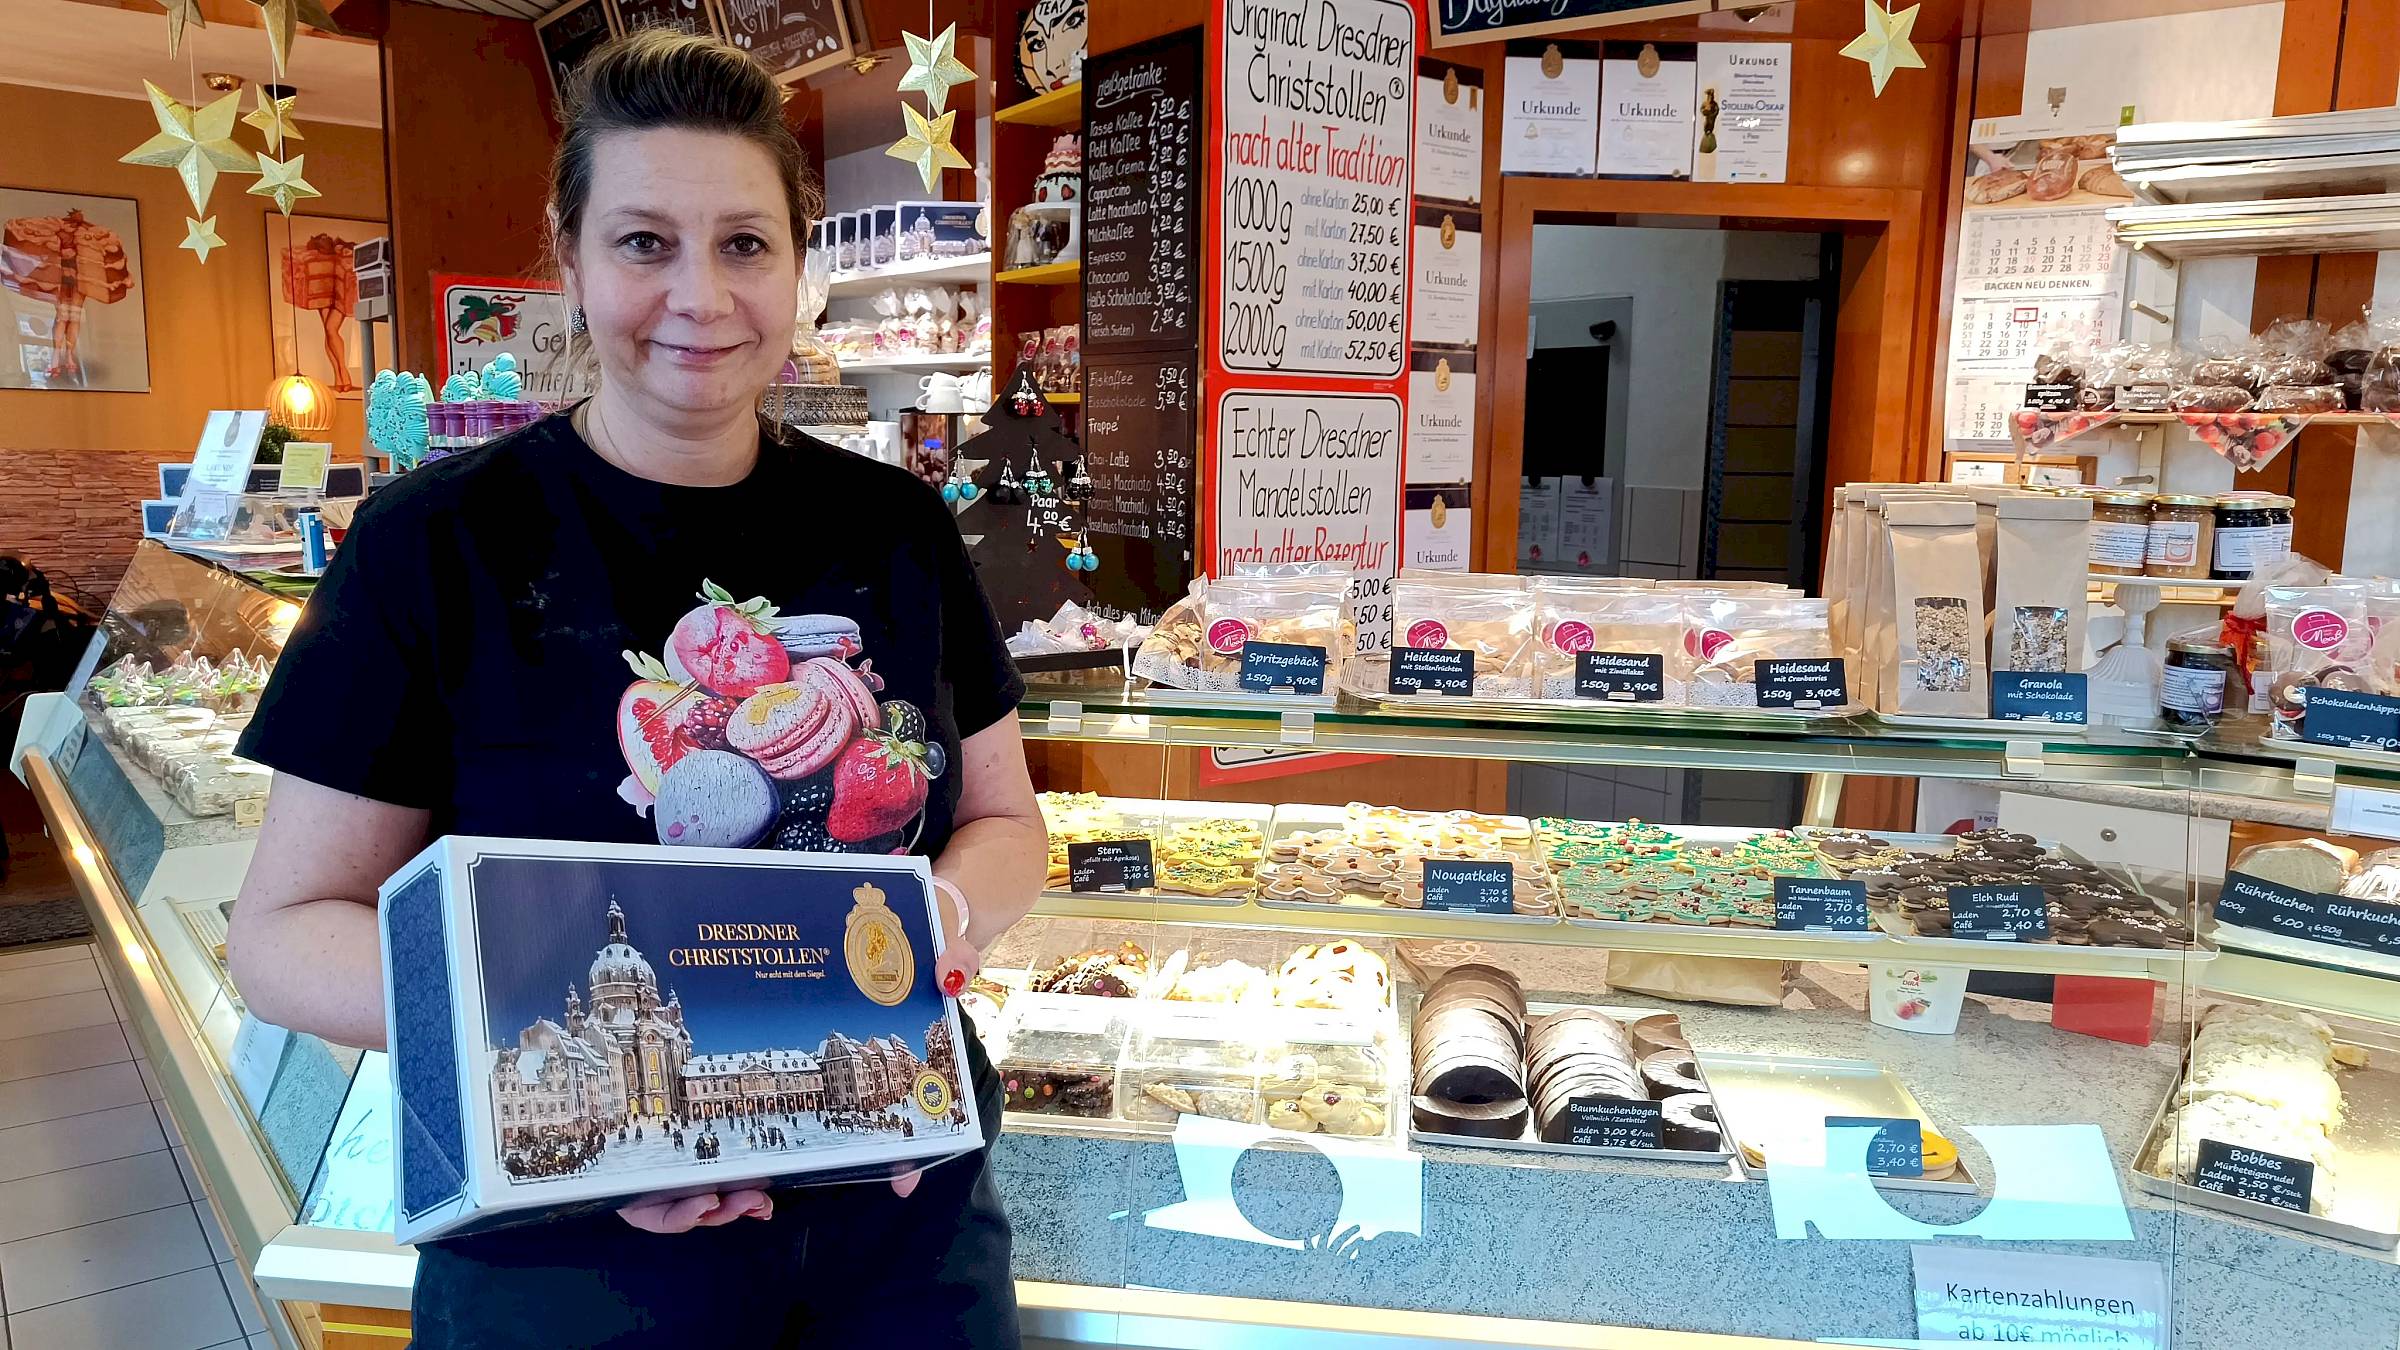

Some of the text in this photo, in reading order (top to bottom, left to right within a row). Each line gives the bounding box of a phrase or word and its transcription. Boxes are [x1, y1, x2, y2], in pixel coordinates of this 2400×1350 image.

[1230, 0, 1308, 52] Original
[1318, 1, 1410, 68] Dresdner
[1148, 97, 1175, 128] 2,50
[1522, 100, 1581, 116] Urkunde
[1619, 102, 1678, 118] Urkunde
[1089, 122, 1174, 159] Pott Kaffee 4,00
[1429, 123, 1471, 143] Urkunde
[1230, 115, 1405, 188] nach alter Tradition
[1088, 162, 1113, 182] Kaffee
[1115, 159, 1146, 176] Crema
[1088, 170, 1173, 205] Cappuccino 3,50
[1088, 192, 1172, 221] Latte Macchiato 4,00
[1351, 193, 1384, 216] 25,00
[1088, 214, 1172, 243] Milchkaffee 4,20
[1349, 222, 1384, 245] 27,50
[1088, 240, 1171, 266] Espresso 2,50
[1348, 252, 1387, 274] 37,50
[1087, 262, 1172, 285] Chococino 3,50
[1425, 270, 1469, 288] Urkunde
[1348, 280, 1387, 303] 40,00
[1984, 281, 2022, 291] BACKEN
[2025, 280, 2046, 289] NEU
[1107, 283, 1175, 308] Schokolade 3,50
[1087, 308, 1174, 333] Tee 2,50
[1347, 310, 1387, 333] 50,00
[1345, 341, 1386, 361] 52,50
[1155, 368, 1178, 391] 5,50
[1155, 391, 1176, 411] 5,50
[1419, 414, 1463, 429] Urkunde
[1232, 408, 1392, 459] Echter Dresdner
[1154, 449, 1178, 471] 3,50
[1157, 473, 1176, 495] 4,50
[1031, 494, 1060, 509] Paar
[1239, 468, 1372, 519] Mandelstollen
[1157, 499, 1176, 519] 4,50
[1027, 509, 1058, 537] 4,00
[1157, 522, 1176, 542] 4,50
[1223, 525, 1390, 575] nach alter Rezeptur
[1417, 550, 1459, 564] Urkunde
[1103, 603, 1120, 620] alles
[1248, 652, 1320, 668] Spritzgebäck
[1404, 651, 1461, 664] Heidesand
[1590, 655, 1650, 668] Heidesand
[1414, 664, 1463, 672] Stollenfrüchten
[1608, 668, 1645, 676] Zimtflakes
[1769, 662, 1831, 674] Heidesand
[1246, 673, 1318, 686] 150g 3,90€
[1394, 676, 1468, 689] 150g 3,90€
[1581, 680, 1658, 692] 150g 3,90€
[1773, 675, 1828, 683] mit Cranberries
[2019, 679, 2063, 690] Granola
[1762, 688, 1841, 701] 150g 3,90€
[2007, 691, 2074, 701] mit Schokolade
[1097, 846, 1122, 855] Stern
[1073, 875, 1090, 883] Café
[1431, 869, 1507, 884] Nougatkeks
[1426, 886, 1499, 896] Laden 2,70
[1426, 893, 1443, 901] Café
[1788, 885, 1851, 896] Tannenbaum
[1972, 892, 2019, 902] Elch Rudi
[2235, 882, 2315, 914] Rührkuchen
[1777, 902, 1852, 912] Laden 2,70
[1952, 909, 2030, 919] Laden 2,70
[2220, 900, 2304, 930] 600g 6,00
[1777, 911, 1852, 925] Café 3,40
[1953, 921, 2032, 930] Café 3,40
[698, 924, 800, 941] DRESDNER
[2314, 924, 2343, 937] 650g
[755, 970, 768, 979] Nur
[769, 970, 782, 978] echt
[783, 970, 793, 978] mit
[794, 970, 807, 978] dem
[1570, 1104, 1659, 1118] Baumkuchenbogen
[1573, 1126, 1627, 1136] Laden 3,00
[1877, 1144, 1905, 1154] 2,70
[1877, 1157, 1906, 1167] 3,40
[2230, 1150, 2282, 1170] Bobbes
[2200, 1168, 2268, 1190] Laden 2,50
[2214, 1161, 2295, 1185] Mürbeteigstrudel
[2198, 1180, 2267, 1201] Café 3,15
[1946, 1282, 2135, 1317] Kartenzahlungen
[1959, 1322, 1985, 1341] ab
